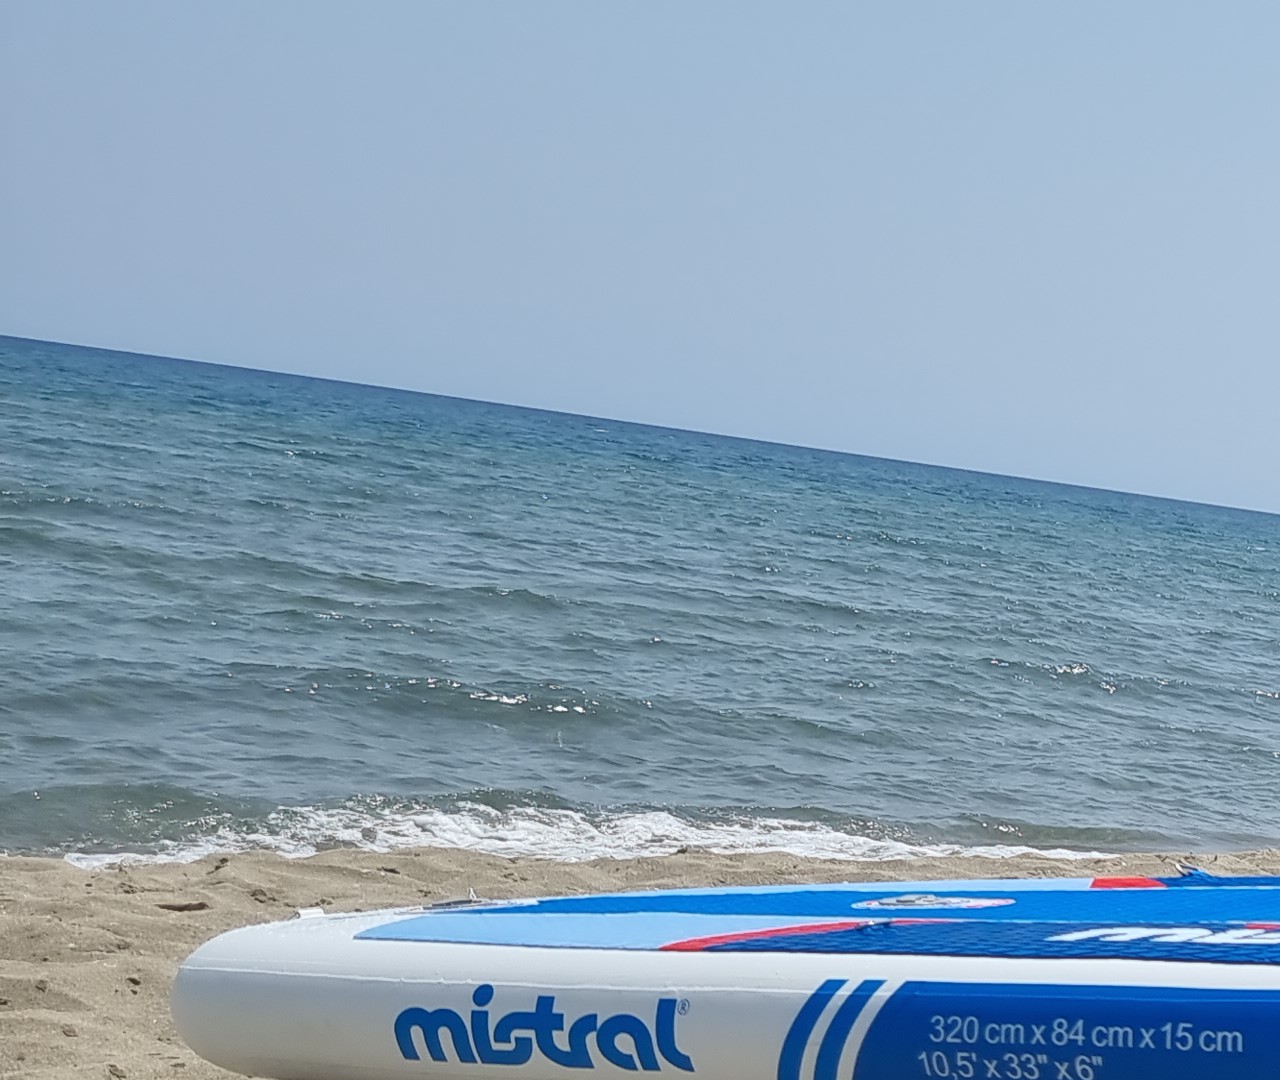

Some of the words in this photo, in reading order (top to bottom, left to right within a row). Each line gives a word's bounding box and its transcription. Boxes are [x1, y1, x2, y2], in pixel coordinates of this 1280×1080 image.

[929, 1015, 979, 1044] 320
[984, 1021, 1025, 1045] cm
[1030, 1024, 1047, 1045] x
[1051, 1018, 1086, 1046] 84
[1091, 1025, 1134, 1048] cm
[1138, 1027, 1155, 1049] x
[1160, 1021, 1194, 1051] 15
[1199, 1029, 1243, 1053] cm
[984, 1059, 1001, 1079] x
[1054, 1060, 1073, 1080] x
